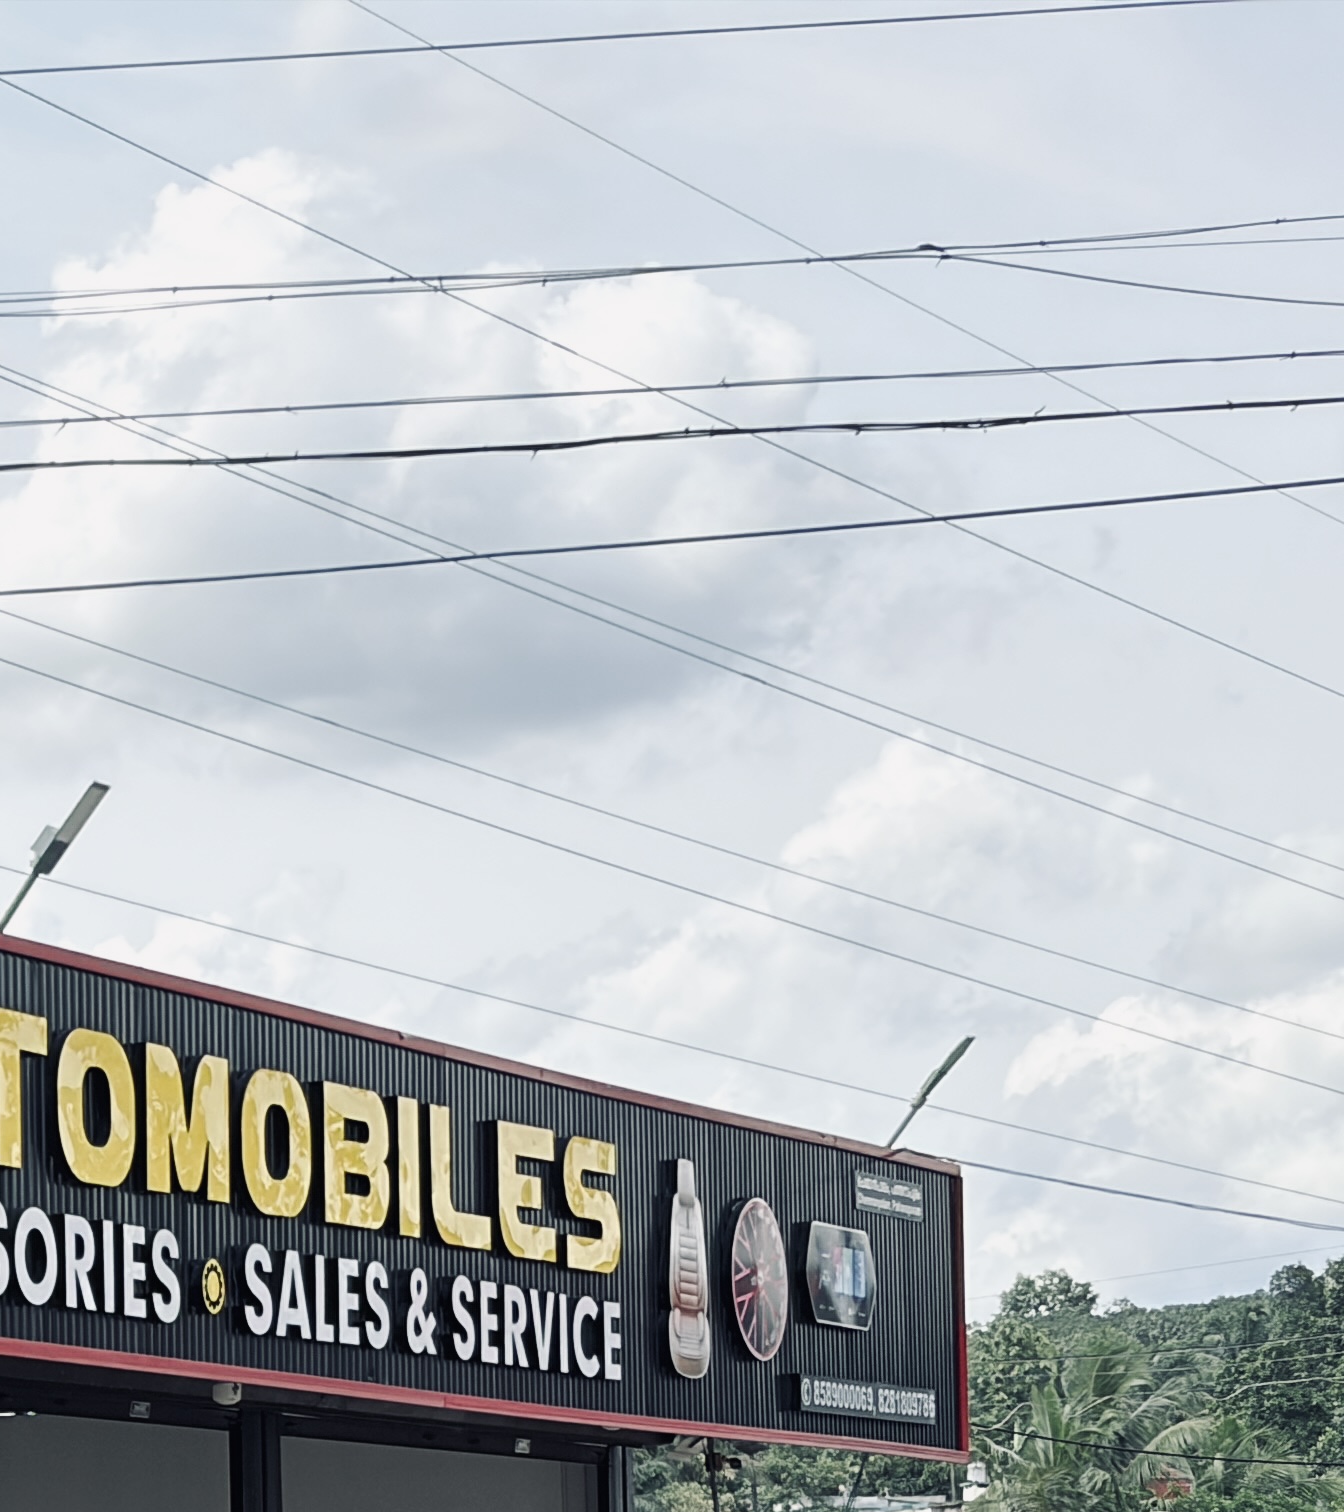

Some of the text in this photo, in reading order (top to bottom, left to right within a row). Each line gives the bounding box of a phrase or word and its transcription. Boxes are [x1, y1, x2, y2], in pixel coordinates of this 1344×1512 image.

[244, 1243, 390, 1350] SALES
[406, 1267, 437, 1355] &
[452, 1275, 622, 1381] SERVICE
